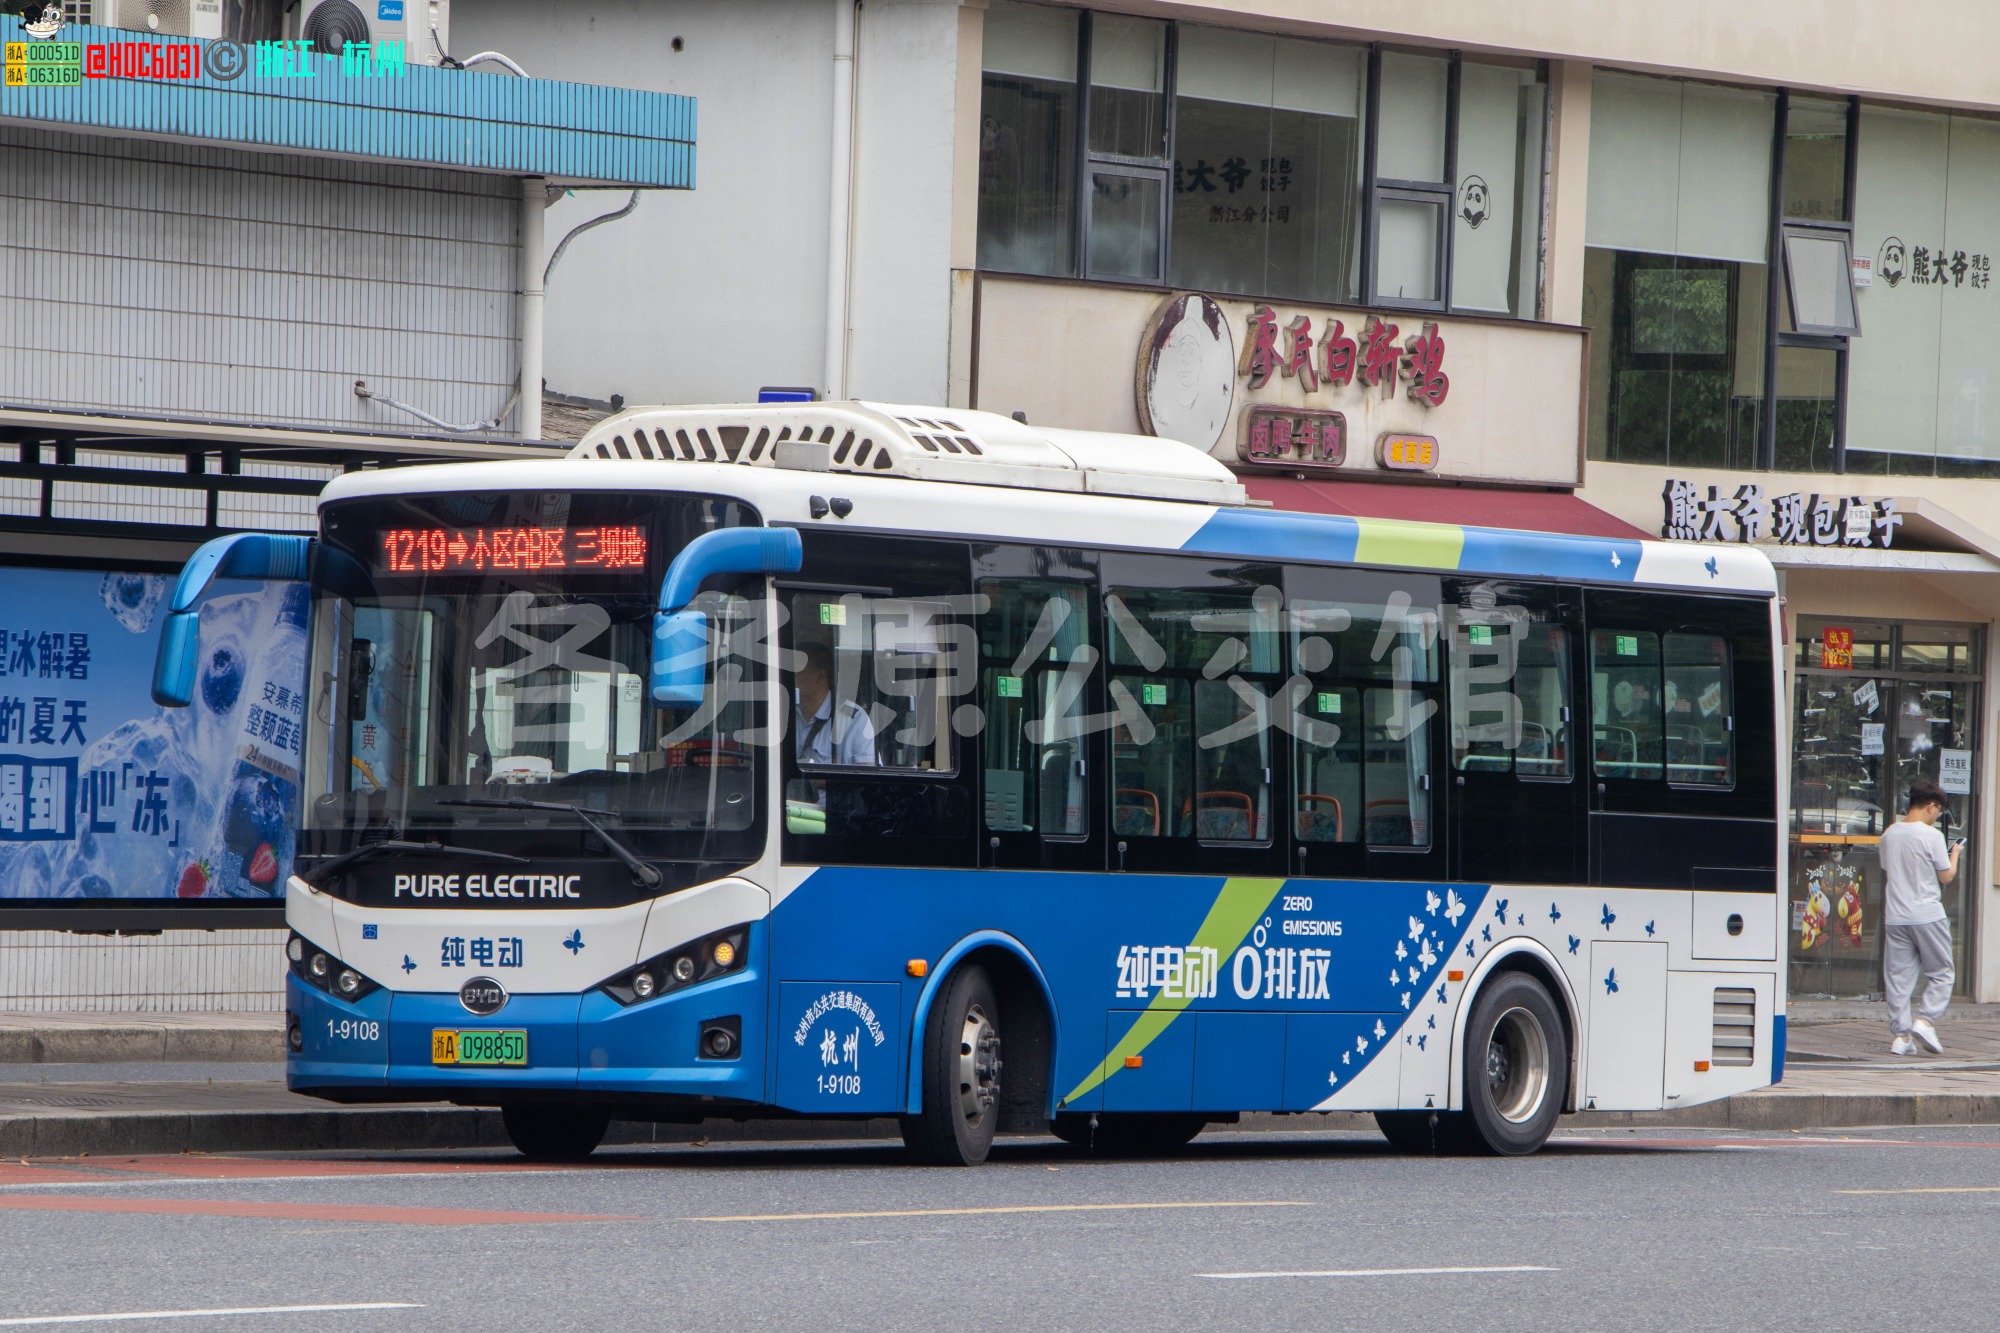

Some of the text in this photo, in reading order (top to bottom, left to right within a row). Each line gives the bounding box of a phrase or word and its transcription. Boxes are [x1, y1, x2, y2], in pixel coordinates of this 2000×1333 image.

[1911, 246, 1969, 288] 熊大爷
[1243, 306, 1449, 407] 廖氏白斩鸡
[1390, 439, 1433, 465] 城西店
[385, 529, 446, 571] 1219
[470, 529, 566, 569] 小区AB区
[262, 681, 302, 715] 安慕希
[0, 695, 87, 746] 的夏天
[393, 874, 581, 899] PURE ELECTRIC
[1282, 896, 1313, 912] ZERO
[1282, 919, 1343, 937] EMISSIONS
[440, 936, 524, 968] 纯电动
[1116, 945, 1218, 999] 纯电动
[464, 988, 500, 1004] BYD
[326, 1018, 380, 1041] 1-9108
[793, 990, 885, 1048] 杭州市公共交通集团有限公司
[819, 1025, 860, 1073] 杭州
[816, 1074, 861, 1095] 1-9108
